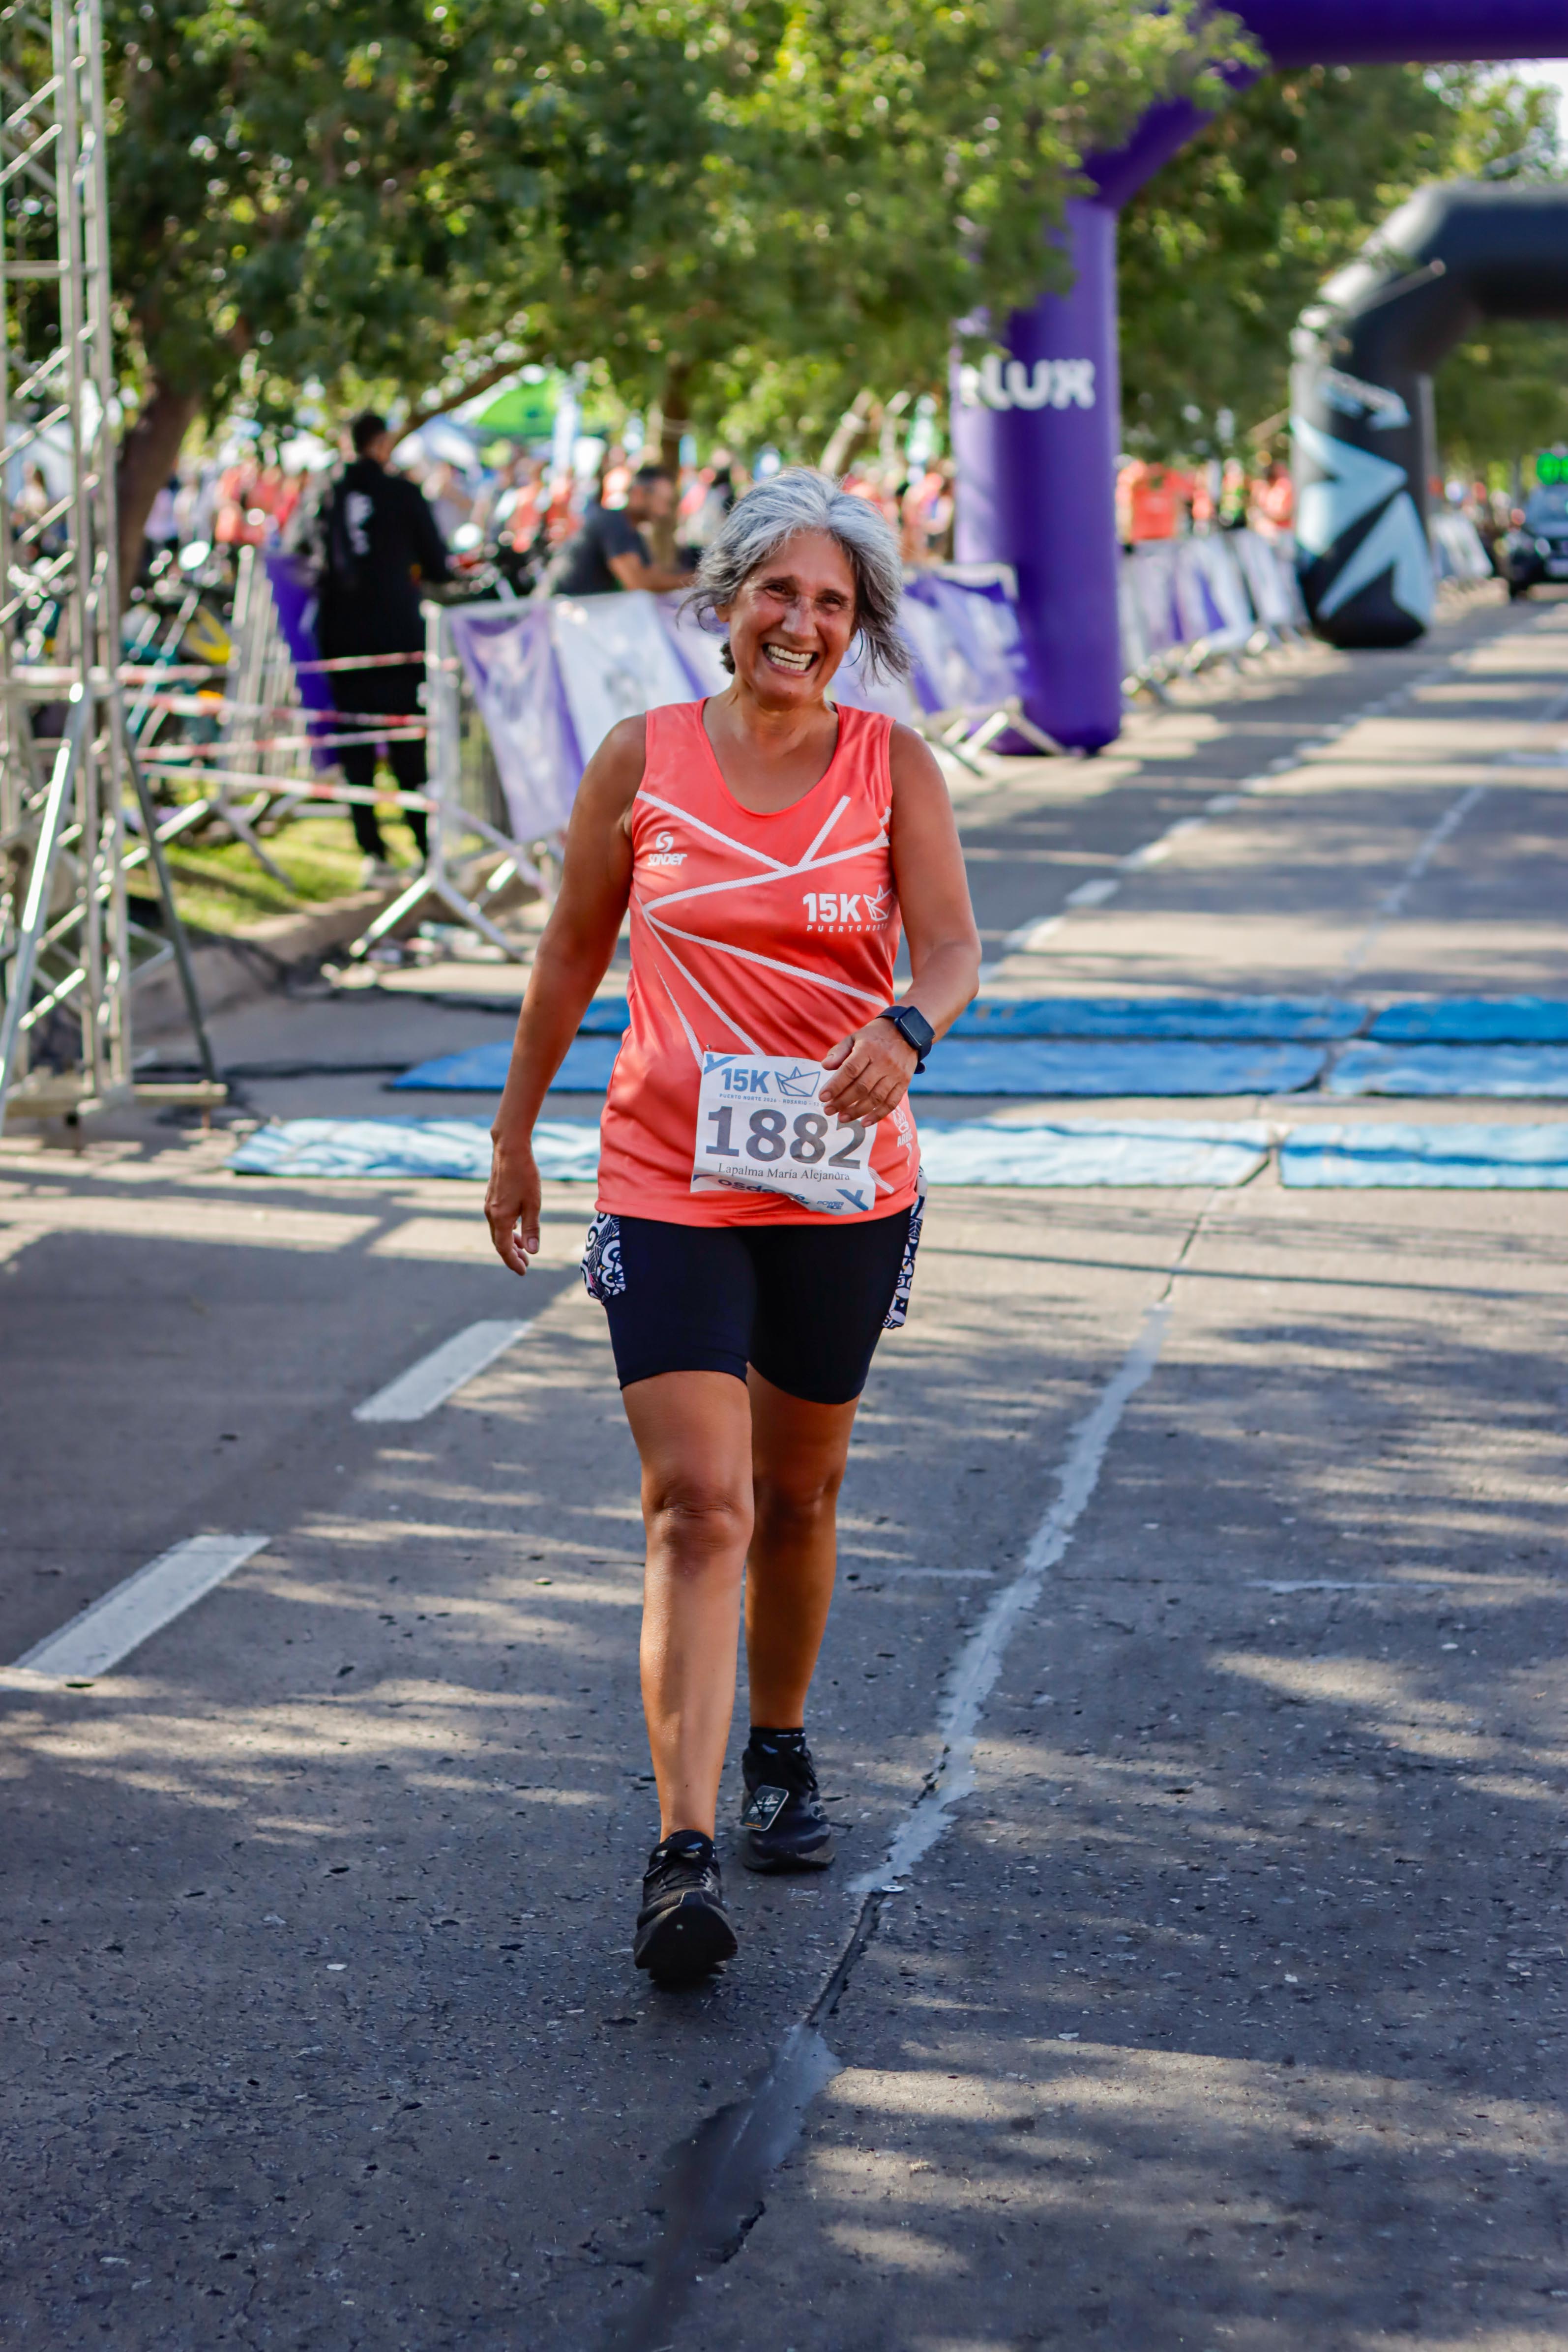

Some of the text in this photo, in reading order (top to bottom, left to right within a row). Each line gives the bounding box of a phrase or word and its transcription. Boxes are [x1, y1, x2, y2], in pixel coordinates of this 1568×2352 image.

[803, 893, 862, 923] 15K
[721, 1068, 770, 1094] 15K
[706, 1106, 866, 1170] 1882
[718, 1162, 850, 1182] Lapalma María Alejandra
